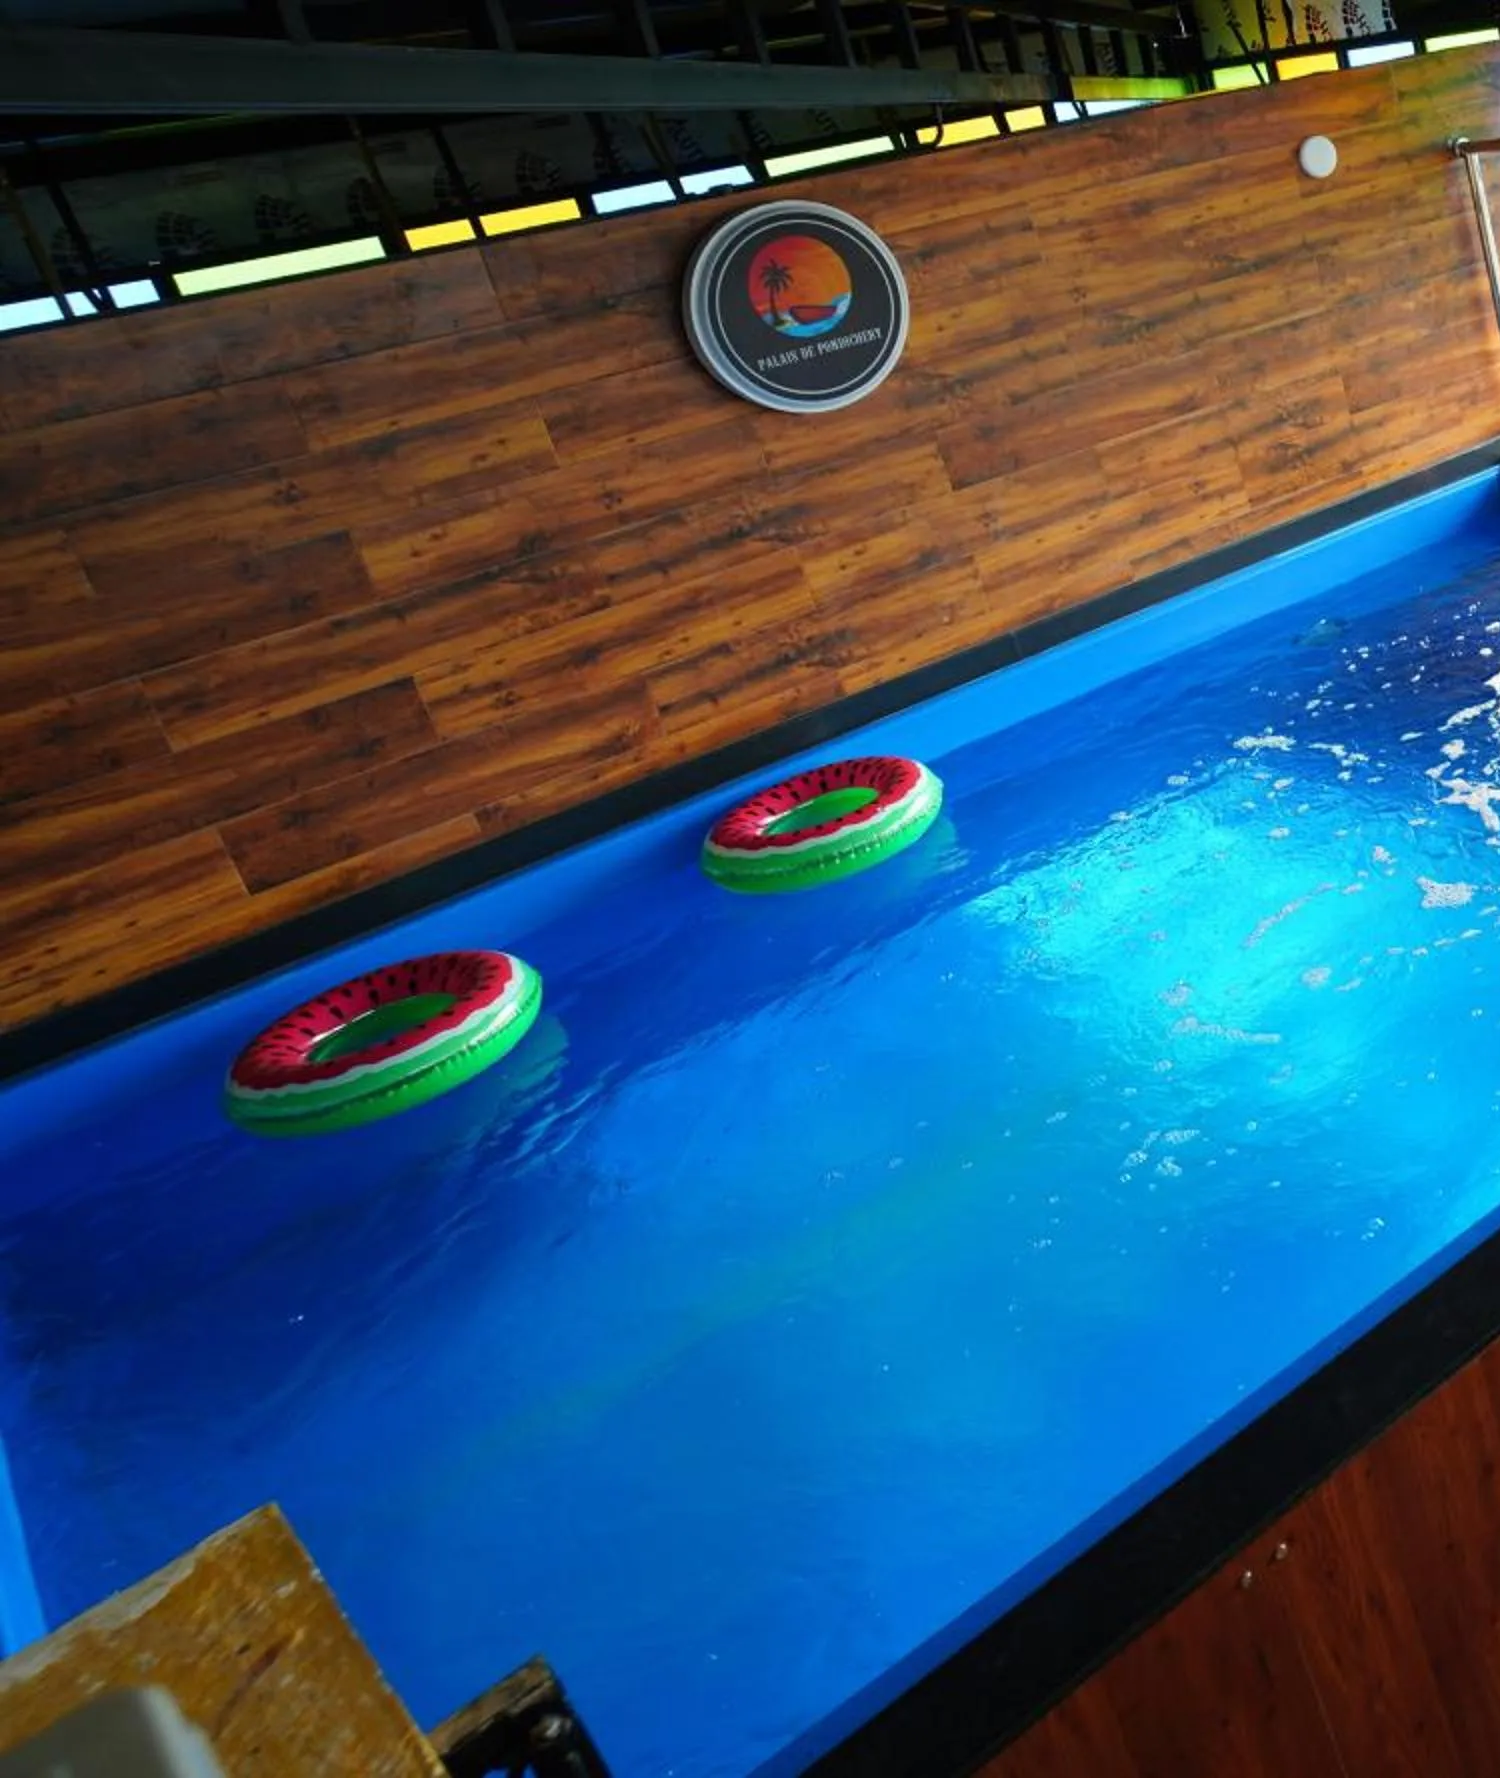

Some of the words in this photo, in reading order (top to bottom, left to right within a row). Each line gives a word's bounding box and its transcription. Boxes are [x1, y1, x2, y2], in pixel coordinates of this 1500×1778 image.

[757, 349, 799, 371] PALAIS
[800, 345, 816, 360] DE
[817, 327, 882, 356] PONDICHERY
